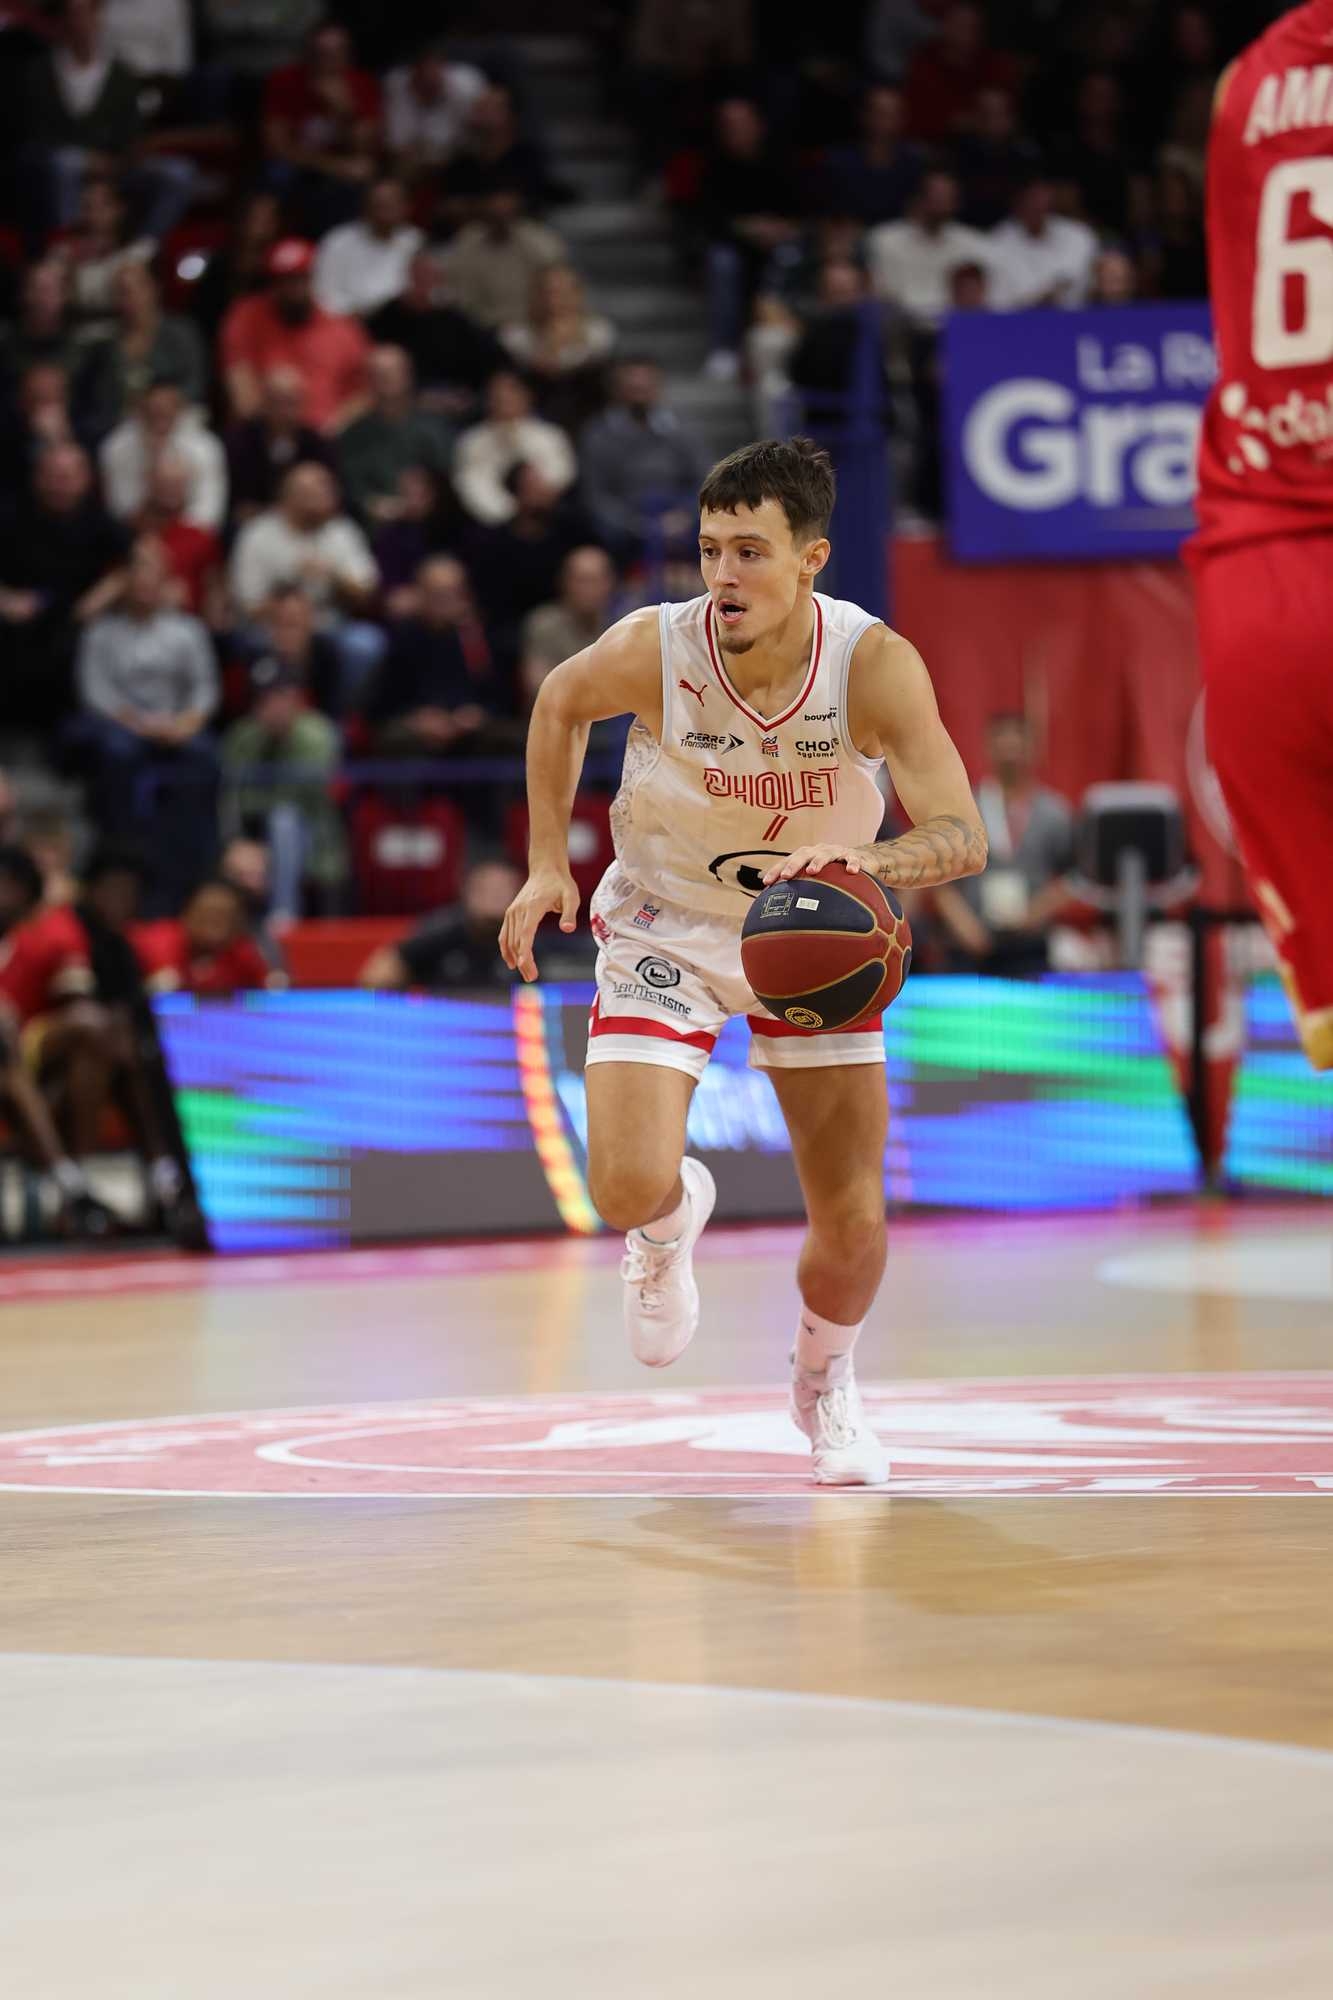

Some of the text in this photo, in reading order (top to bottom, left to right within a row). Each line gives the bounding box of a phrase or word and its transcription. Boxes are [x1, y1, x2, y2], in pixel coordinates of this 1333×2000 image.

[1077, 335, 1156, 391] La
[680, 738, 719, 751] Transports
[703, 767, 839, 811] CHOLET
